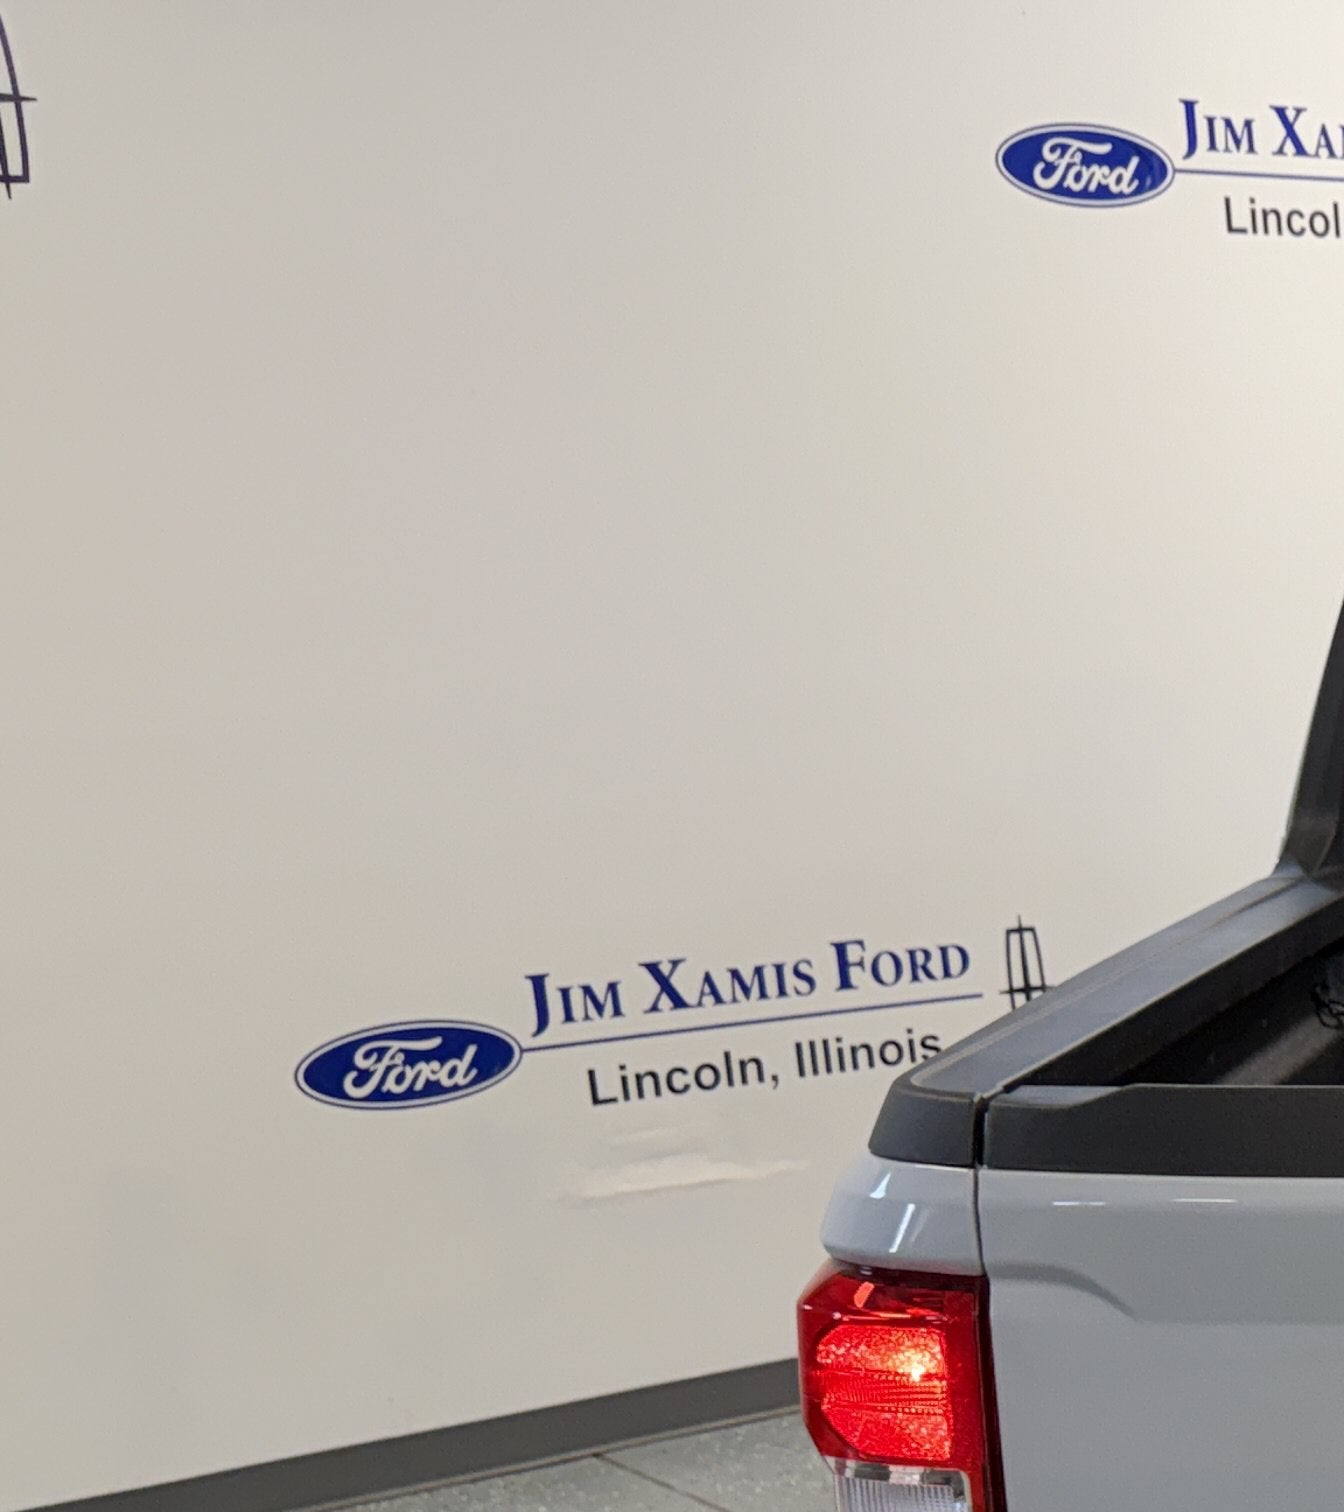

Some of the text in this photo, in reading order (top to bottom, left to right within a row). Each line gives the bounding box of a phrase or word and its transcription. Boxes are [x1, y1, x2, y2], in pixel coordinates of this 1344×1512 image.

[1178, 98, 1256, 160] JIM
[1032, 136, 1140, 196] Ford
[523, 939, 971, 1037] JIM XAMIS FORD
[342, 1035, 478, 1100] Ford
[586, 1028, 943, 1106] Lincoln, Illinois
